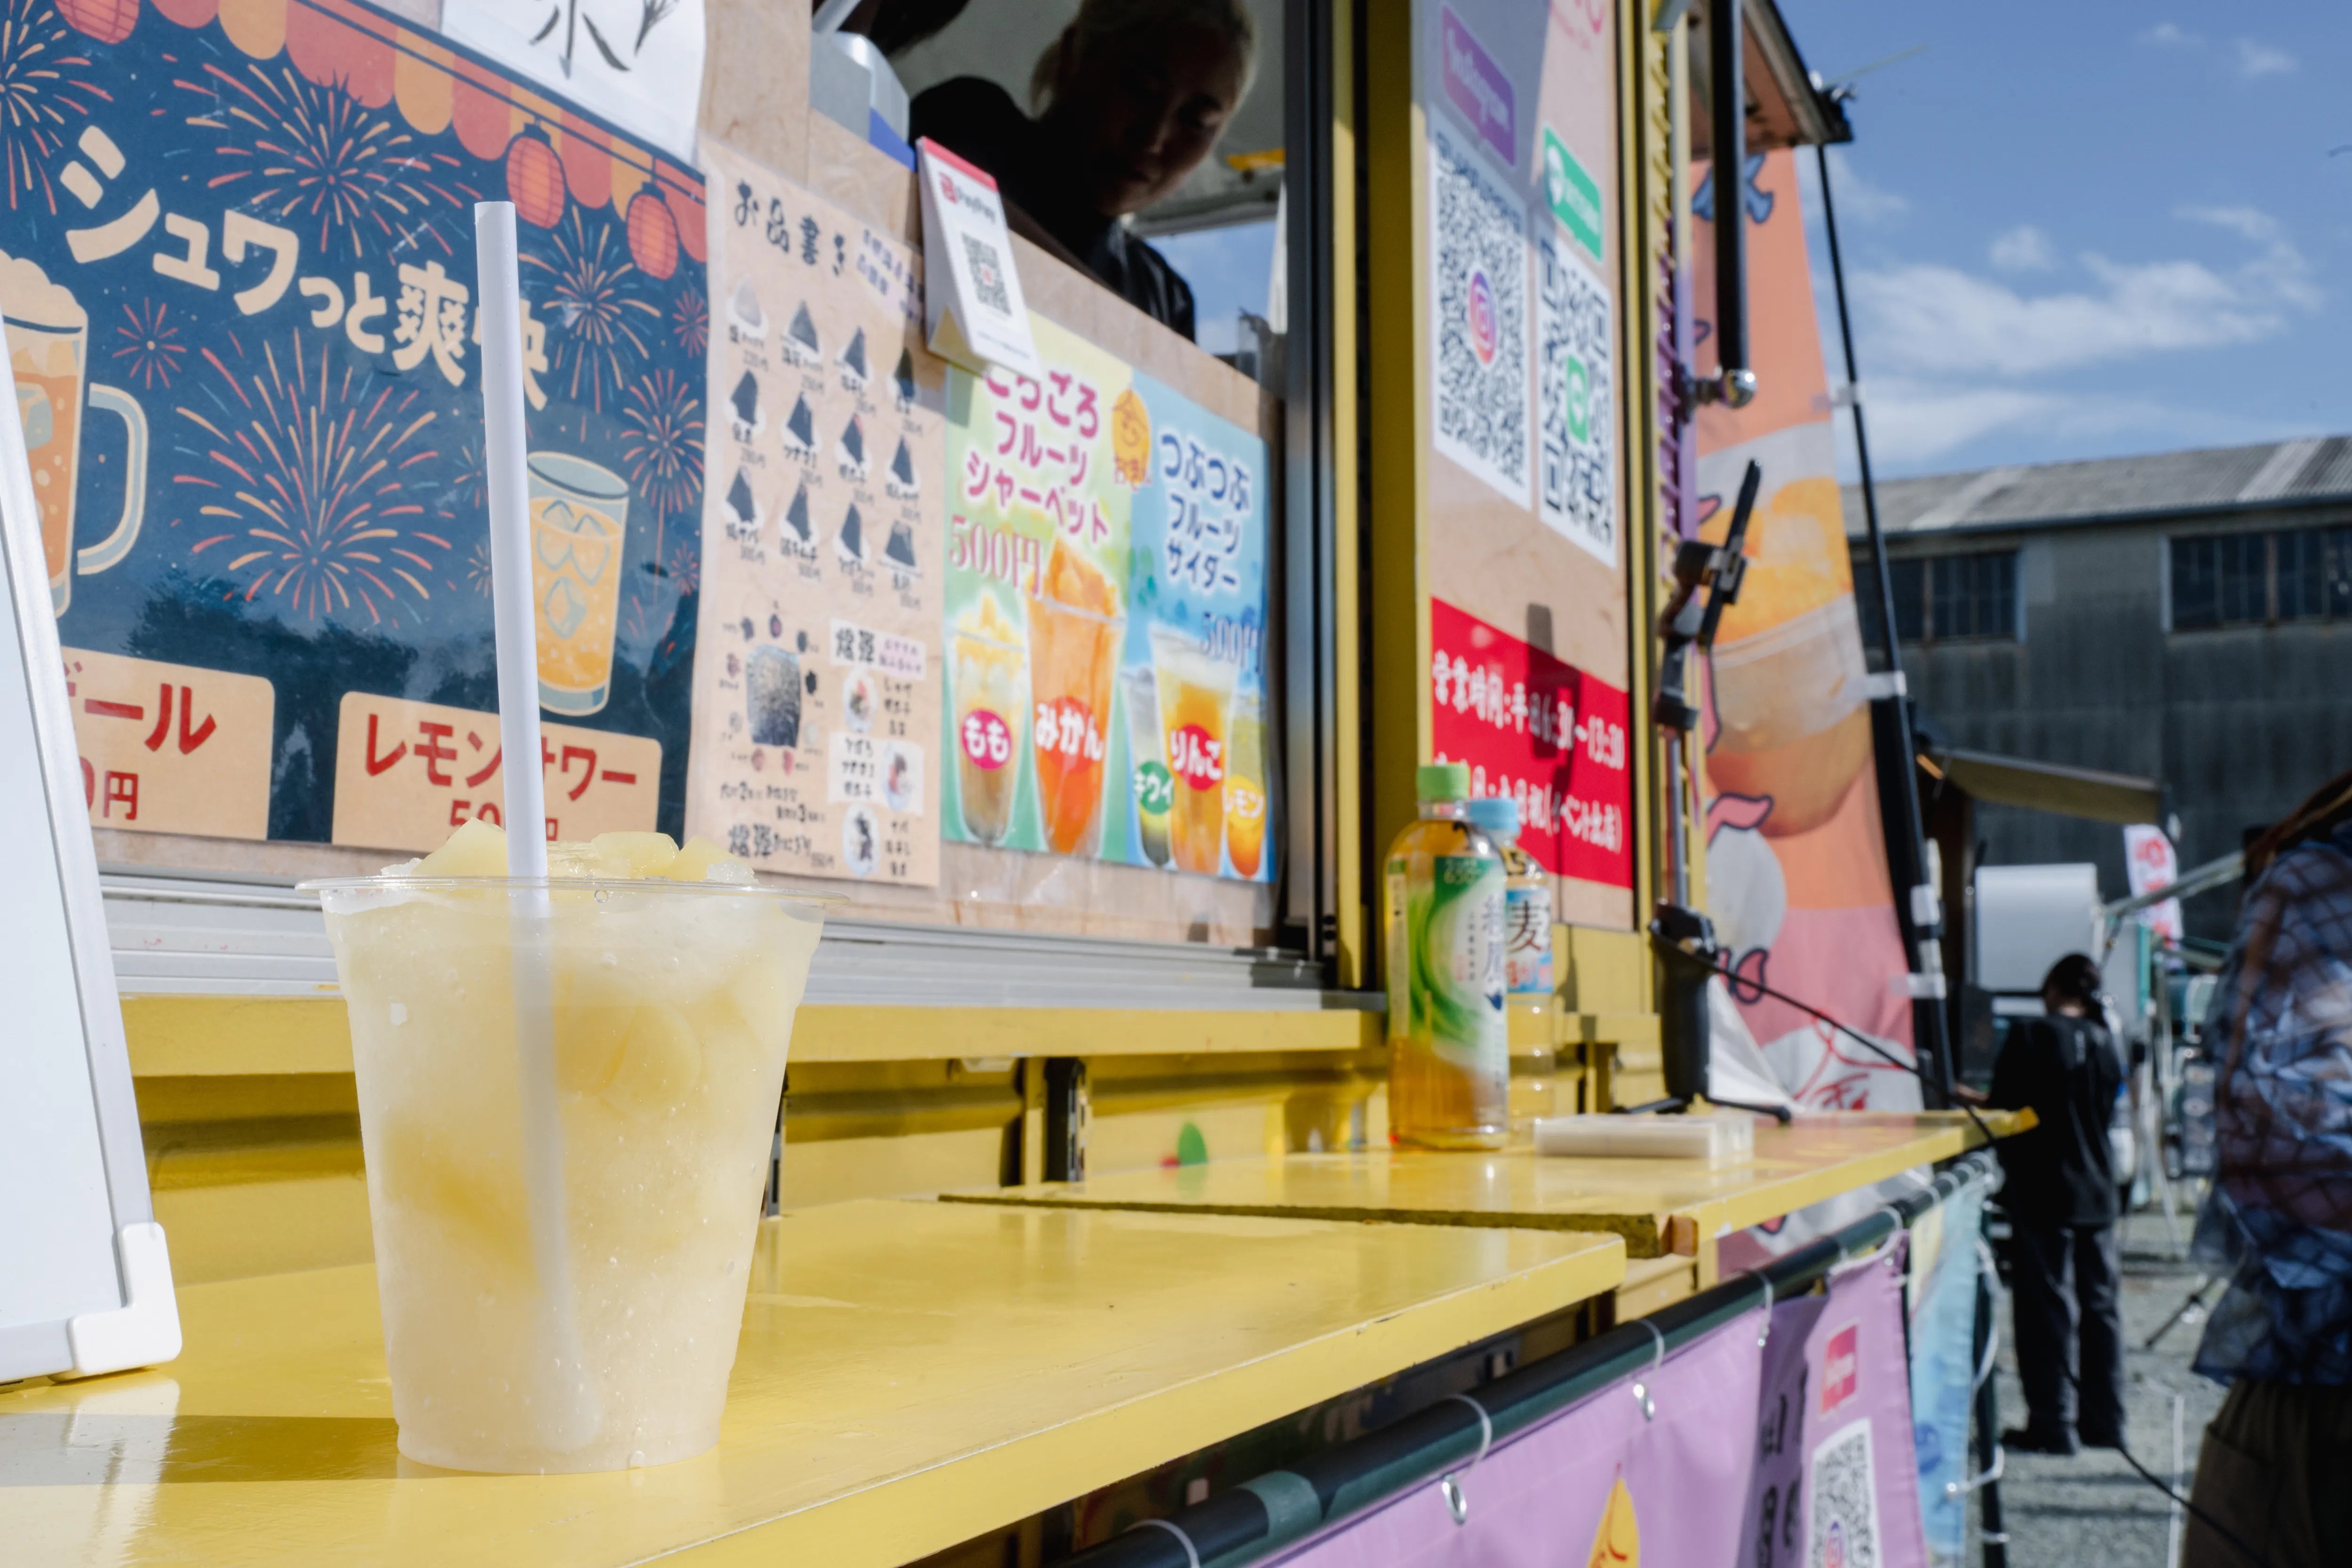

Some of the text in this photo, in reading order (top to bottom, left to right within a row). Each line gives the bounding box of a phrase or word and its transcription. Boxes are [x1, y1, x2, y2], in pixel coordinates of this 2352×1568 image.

[735, 179, 847, 276] お品書き
[995, 410, 1088, 487] フルーツ
[1161, 433, 1251, 512] つぶつぶ
[967, 451, 1109, 543] シャーベット
[1170, 493, 1241, 554] フルーツ
[949, 513, 1042, 597] 500円
[1168, 538, 1238, 589] サイダー
[965, 716, 1011, 762] もも
[1035, 703, 1104, 762] みかん
[1170, 729, 1224, 780] りんご
